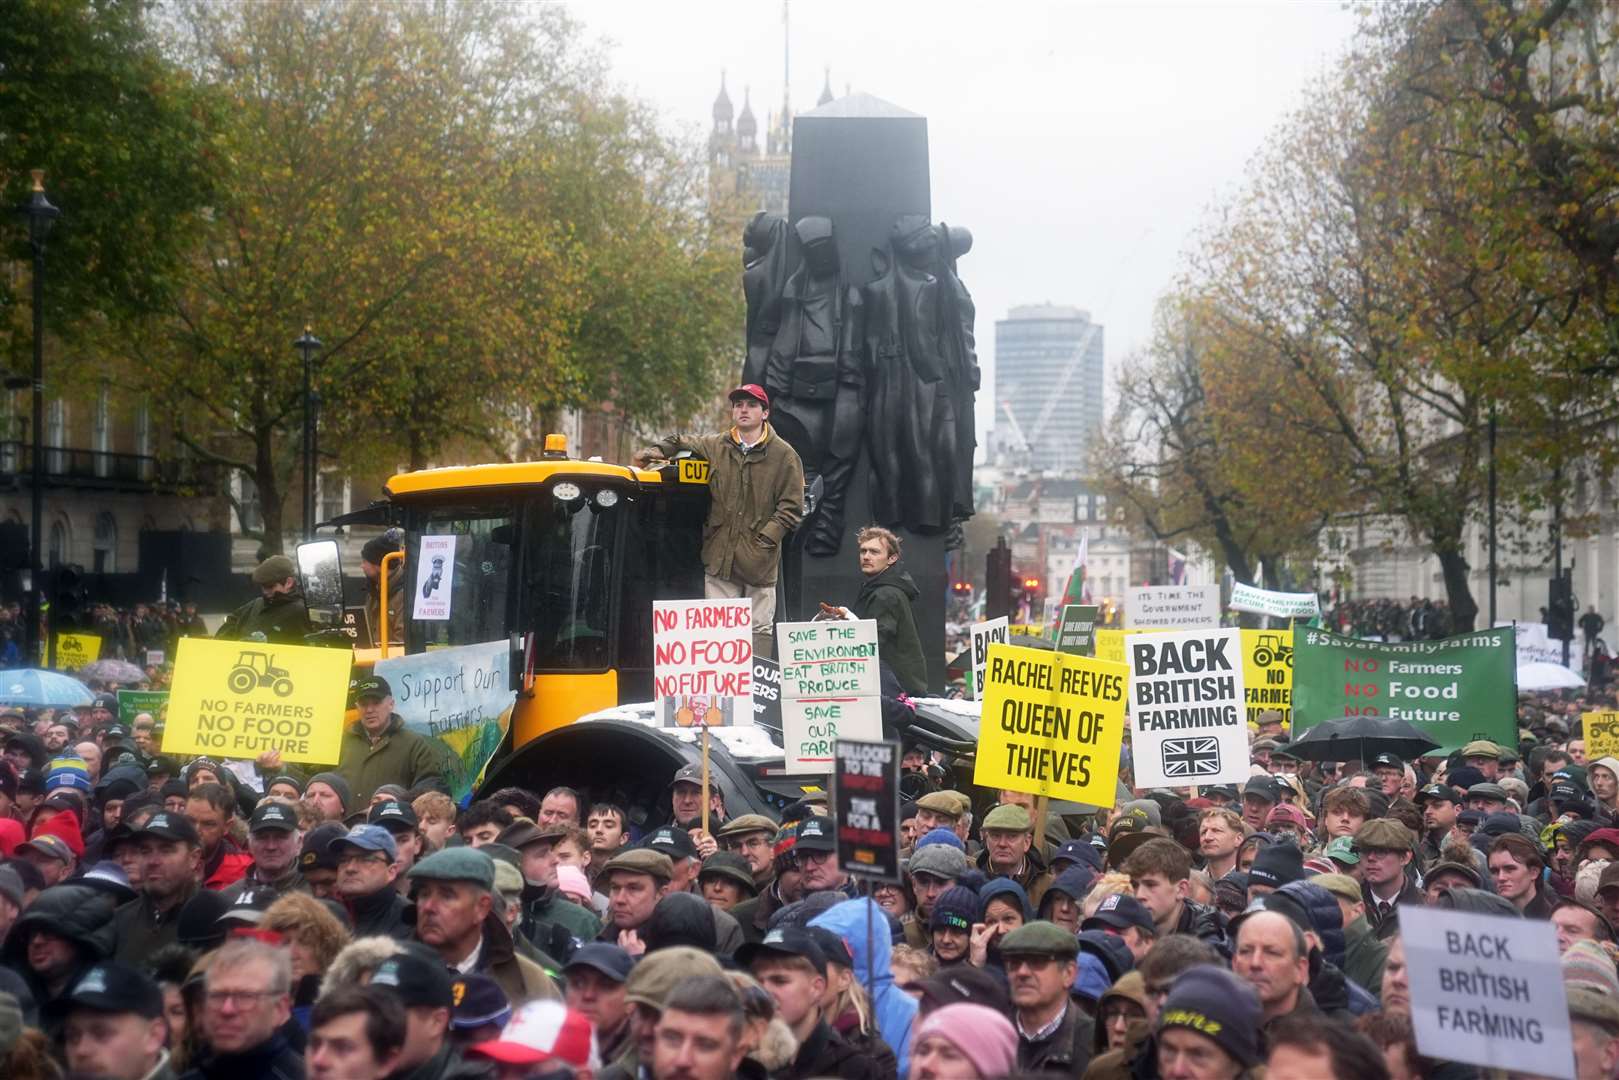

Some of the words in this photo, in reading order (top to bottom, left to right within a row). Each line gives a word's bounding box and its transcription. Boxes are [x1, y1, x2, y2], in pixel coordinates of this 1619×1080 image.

[685, 463, 710, 480] CU7
[1158, 591, 1180, 599] TIME
[1187, 591, 1204, 599] THE
[654, 609, 678, 634] NO
[686, 606, 751, 630] FARMERS
[1170, 616, 1213, 624] FARMERS
[788, 629, 817, 644] SAVE
[826, 628, 856, 640] THE
[1306, 631, 1501, 655] #SaveFamilyFarms
[655, 640, 687, 666] NO
[691, 638, 752, 665] FOOD
[793, 642, 877, 661] ENVIRONMENT
[1133, 637, 1232, 677] BACK
[753, 665, 781, 685] OUR
[783, 664, 813, 680] EAT
[820, 661, 866, 677] BRITISH
[1344, 657, 1380, 673] NO
[1389, 660, 1463, 675] Farmers
[400, 666, 465, 708] Support
[474, 667, 501, 689] Our
[655, 675, 678, 700] NO
[680, 670, 750, 697] FUTURE
[799, 679, 860, 695] PRODUCE
[991, 657, 1054, 691] RACHEL
[1060, 667, 1123, 702] REEVES
[1266, 669, 1284, 685] NO
[753, 681, 779, 701] ERS
[1136, 676, 1236, 706] BRITISH
[1244, 688, 1292, 705] FARME
[1344, 683, 1380, 698] NO
[1389, 682, 1459, 699] Food
[200, 699, 228, 713] NO
[234, 701, 314, 719] FARMERS
[804, 705, 841, 720] SAVE
[1138, 705, 1238, 732] FARMING
[1344, 704, 1380, 718] NO
[1389, 707, 1460, 722] Future
[197, 714, 235, 732] NO
[243, 717, 312, 738] FOOD
[428, 705, 482, 737] Farmers
[808, 722, 839, 737] OUR
[1001, 699, 1071, 741] QUEEN
[1077, 710, 1104, 745] OF
[195, 732, 226, 748] NO
[233, 735, 309, 754] FUTURE
[800, 741, 834, 756] FAR
[844, 760, 860, 775] TO
[862, 761, 883, 777] THE
[1006, 743, 1091, 787] THIEVES
[847, 813, 870, 829] FOR
[871, 816, 881, 831] A
[1446, 930, 1512, 961] BACK
[1439, 967, 1531, 1003] BRITISH
[1437, 1005, 1544, 1044] FARMING
